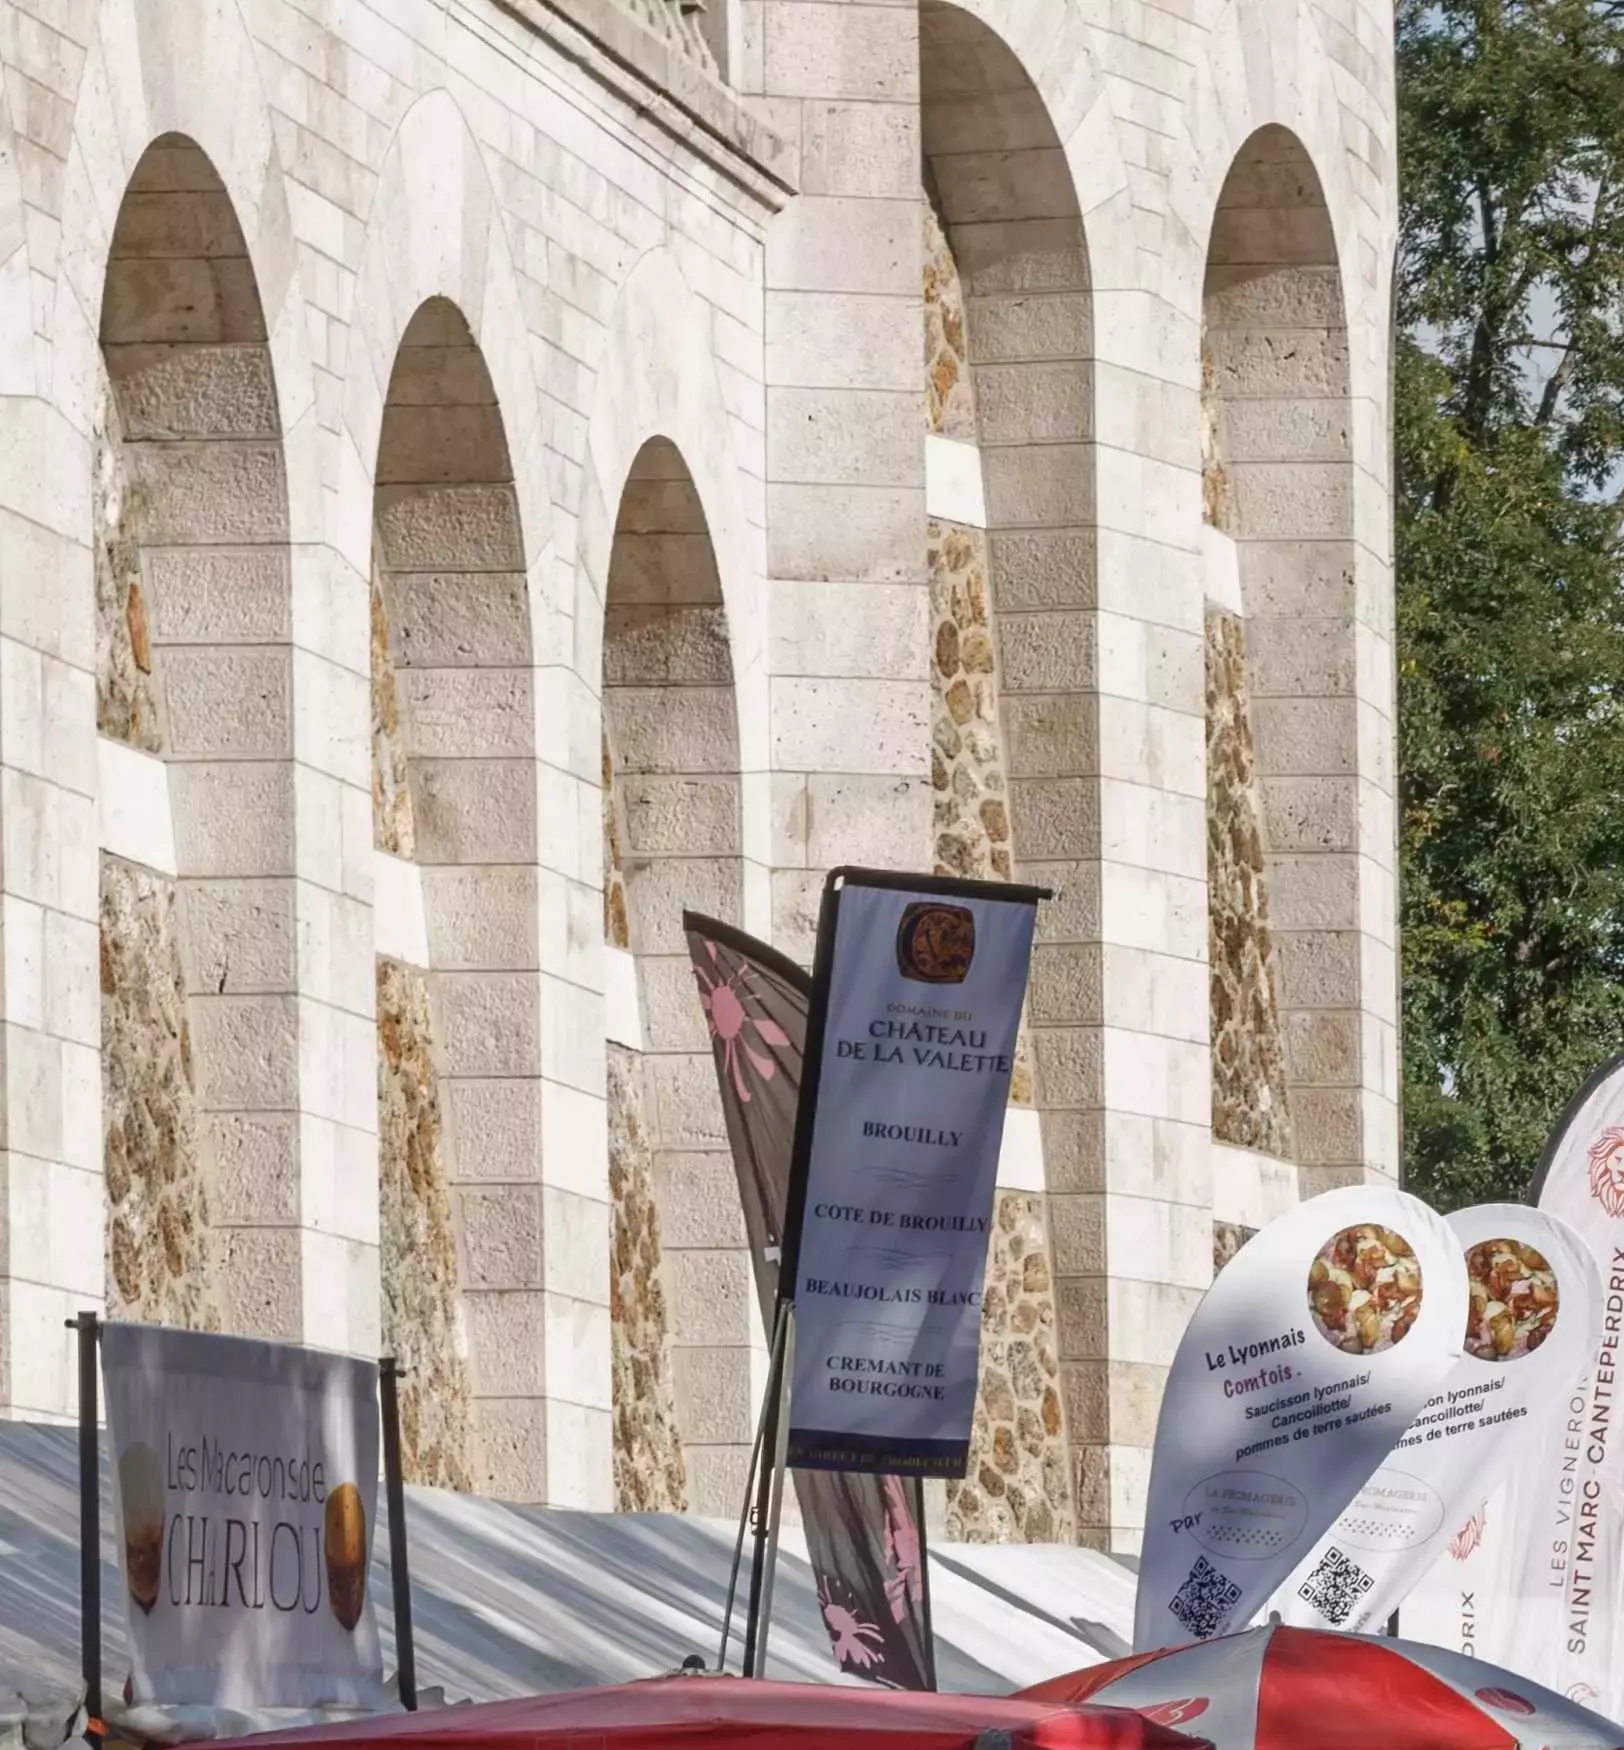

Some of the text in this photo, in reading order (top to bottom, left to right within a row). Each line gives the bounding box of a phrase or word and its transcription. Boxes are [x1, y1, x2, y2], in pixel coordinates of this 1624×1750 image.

[868, 1019, 988, 1049] CHÂTEAU
[836, 1039, 1010, 1074] DE LA VALETTE
[862, 1120, 963, 1147] BROUILLY
[813, 1202, 988, 1233] COTE DE BROUILLY
[804, 1276, 982, 1307] BEAUJOLAIS BLANC
[825, 1353, 946, 1378] CREMANT DE
[1206, 1327, 1307, 1372] Le Lyonnais
[828, 1376, 946, 1401] BOURGOGNE
[1223, 1362, 1293, 1399] Comtois
[1245, 1369, 1372, 1420] Saucisson lyonnais/
[1446, 1375, 1506, 1403] lyonnais/
[1271, 1394, 1352, 1430] Cancoillotte/
[1425, 1427, 1442, 1443] de
[1445, 1419, 1476, 1437] terre
[1479, 1405, 1528, 1429] sautées
[1235, 1401, 1393, 1463] pommes de terre sautées
[167, 1430, 197, 1492] Les
[1549, 1376, 1589, 1587] LES VIGNERO
[1168, 1511, 1204, 1535] par
[1578, 1480, 1602, 1564] MARC
[1567, 1569, 1592, 1655] SAINT
